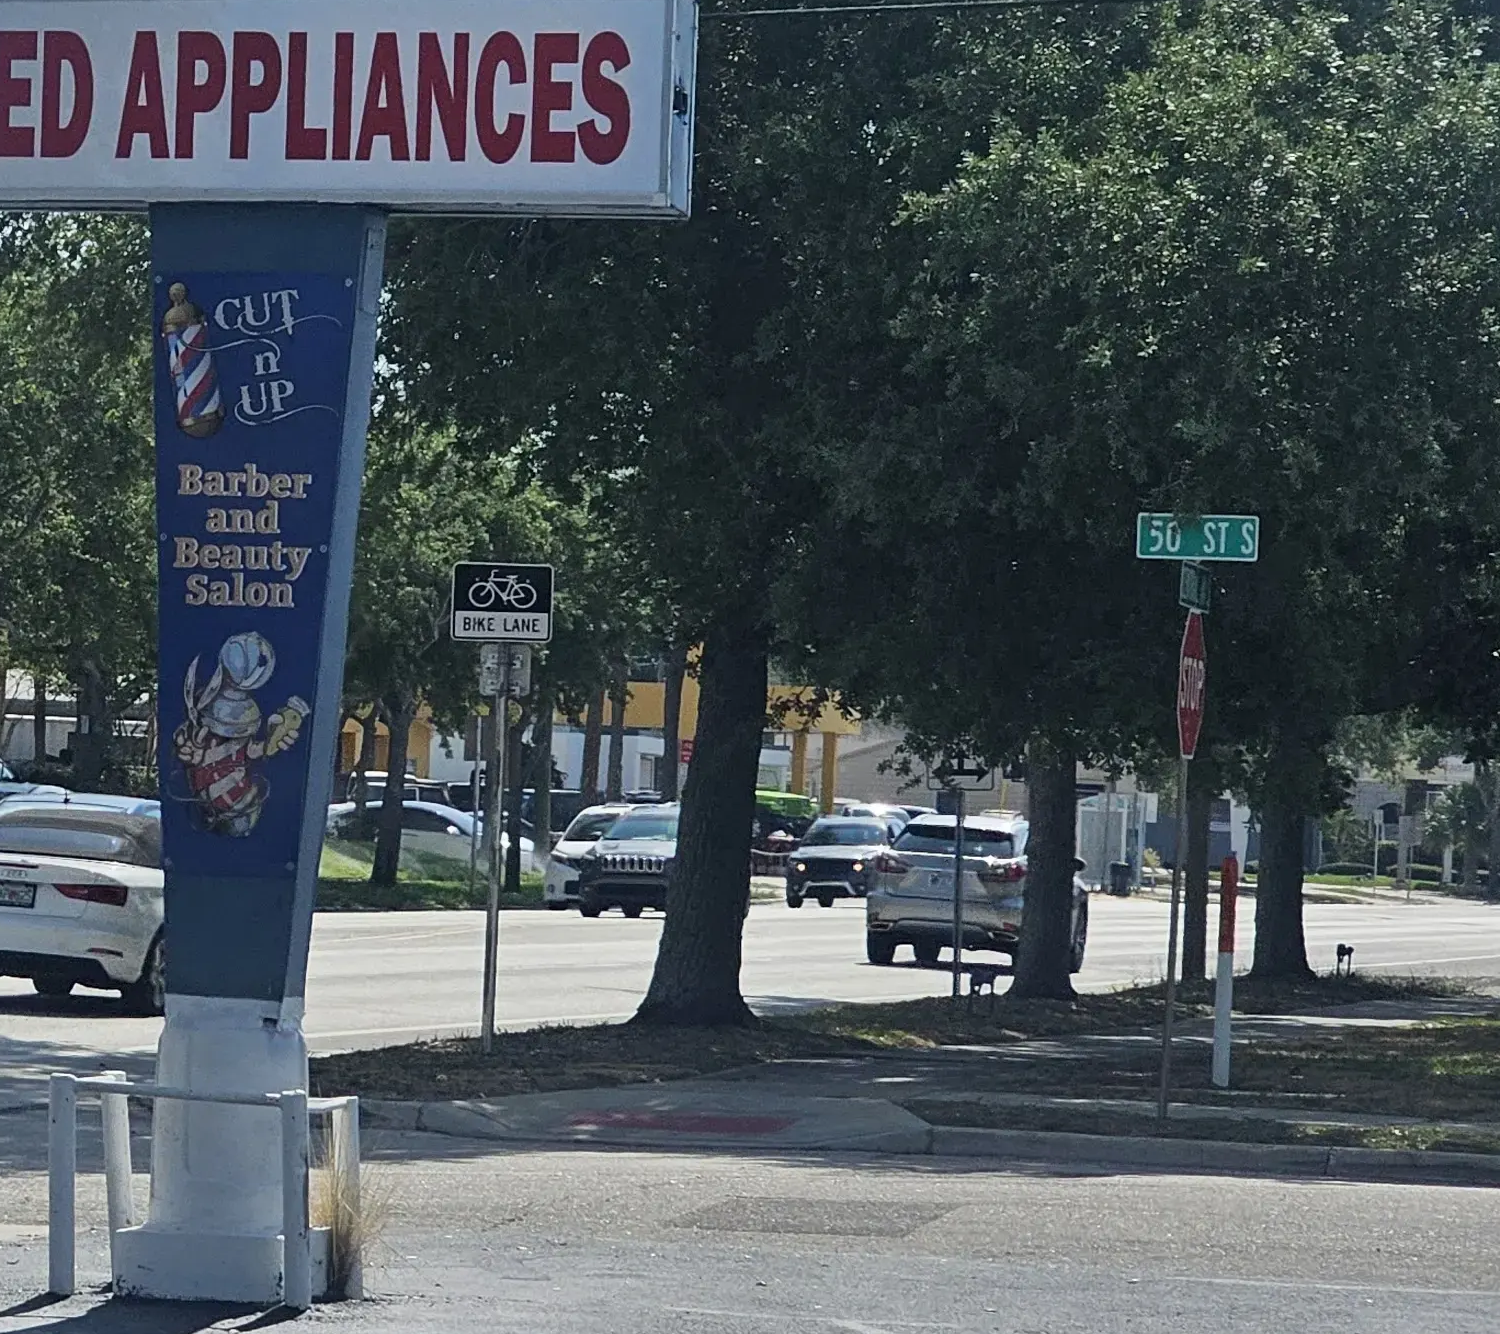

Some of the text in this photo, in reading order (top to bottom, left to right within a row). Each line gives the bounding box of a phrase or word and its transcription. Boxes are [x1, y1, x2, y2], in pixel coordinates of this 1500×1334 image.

[115, 29, 632, 166] APPLIANCES
[214, 288, 300, 336] CUT
[235, 379, 297, 425] UP
[177, 463, 312, 499] Barber
[205, 500, 281, 535] and
[1149, 519, 1255, 555] 50 ST S
[172, 537, 313, 581] Beauty
[184, 572, 296, 609] Salon
[462, 617, 541, 633] BIKE LANE
[1180, 656, 1205, 711] STOP
